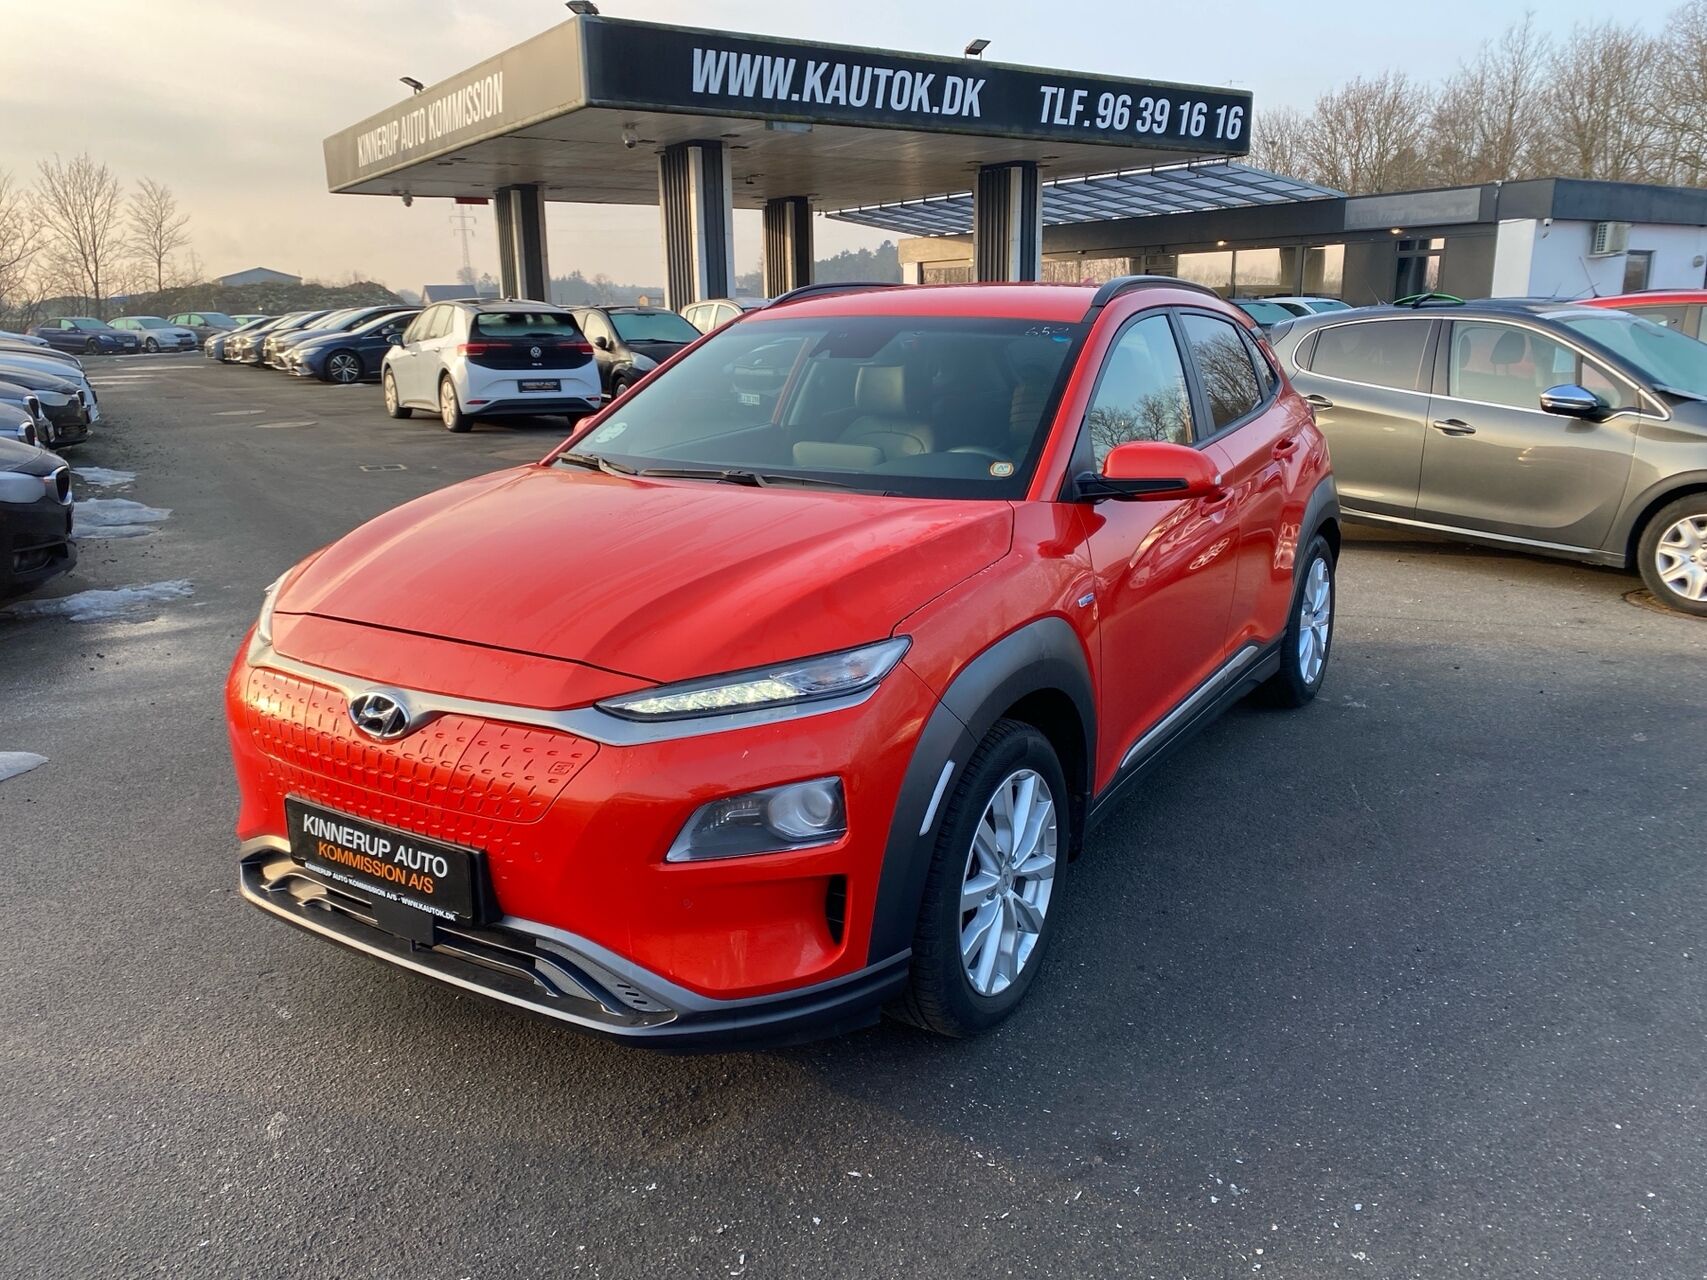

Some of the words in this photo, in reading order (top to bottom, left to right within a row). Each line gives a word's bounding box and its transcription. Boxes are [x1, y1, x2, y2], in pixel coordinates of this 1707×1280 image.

[692, 48, 986, 118] WWW.KAUTOK.DK
[1040, 85, 1090, 127] TLF.
[1096, 92, 1132, 131] 96
[1136, 96, 1171, 134] 39
[1179, 101, 1208, 137] 16
[1216, 105, 1244, 140] 16
[357, 120, 399, 168] KINNERUP
[400, 107, 426, 151] AUTO
[428, 71, 503, 140] KOMMISSION
[303, 813, 391, 858] KINNERUP
[394, 845, 448, 878] AUTO
[318, 841, 406, 885] KOMMISSION
[409, 873, 434, 894] A/S
[305, 862, 332, 877] KINNERUP
[332, 872, 348, 884] AUTO
[348, 877, 386, 897] KOMMISSION
[386, 891, 398, 901] A/S
[401, 897, 456, 922] WWW.KAUTOK.DK
